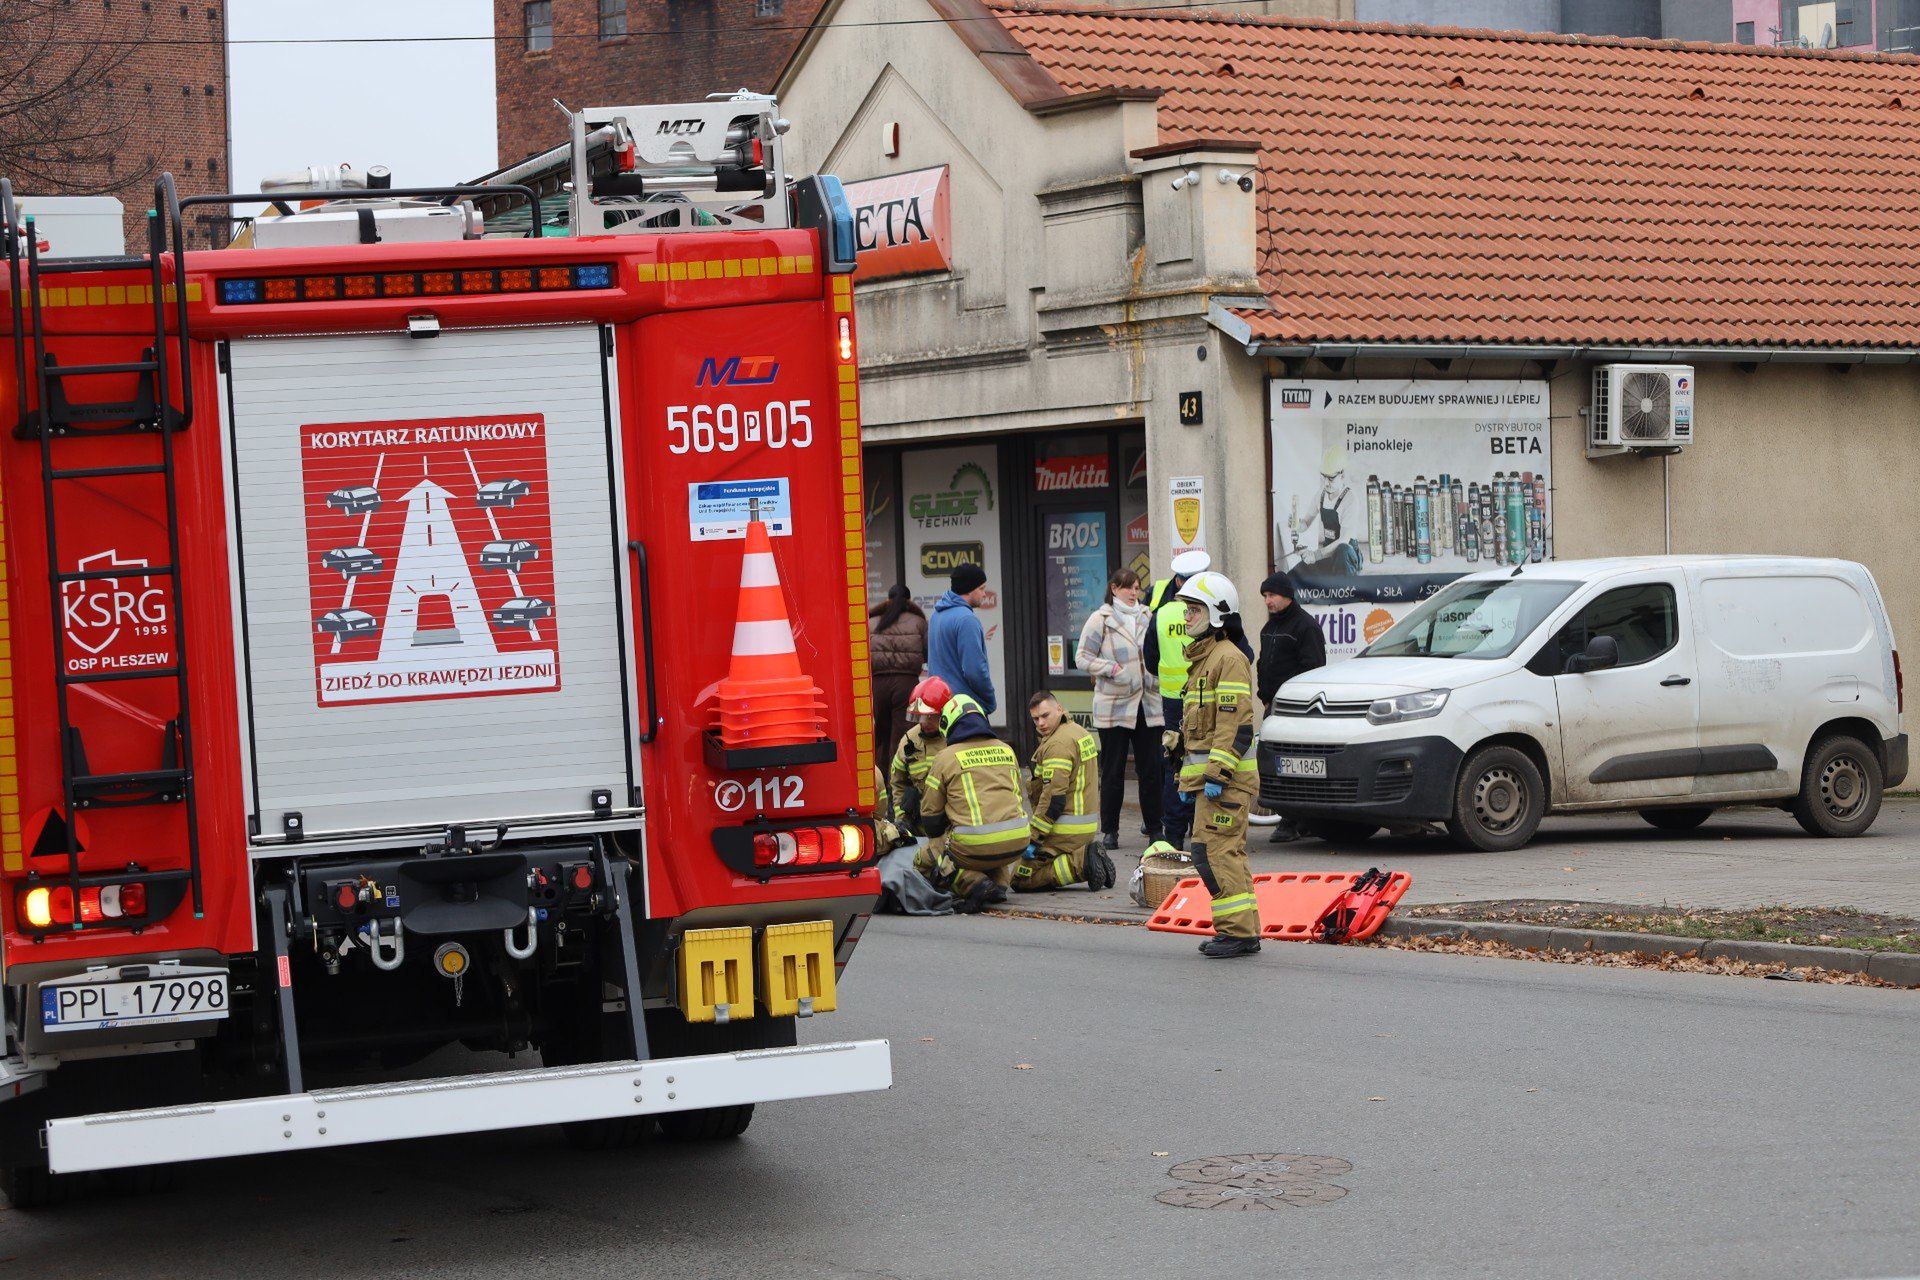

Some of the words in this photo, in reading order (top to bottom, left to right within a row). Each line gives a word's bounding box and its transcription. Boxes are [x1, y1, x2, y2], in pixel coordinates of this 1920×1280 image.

[1283, 389, 1311, 403] TYTAN
[1338, 394, 1376, 405] RAZEM
[1379, 394, 1435, 405] BUDUJEMY
[1438, 394, 1499, 405] SPRAWNIEJ
[1507, 395, 1541, 405] LEPIEJ
[1181, 397, 1197, 417] 43
[1346, 423, 1378, 438] Piany
[1474, 423, 1543, 433] DYSTRYBUTOR
[311, 428, 410, 450] KORYTARZ
[415, 422, 539, 445] RATUNKOWY
[1353, 440, 1413, 454] pianokleje
[1491, 437, 1542, 455] BETA
[917, 516, 972, 529] TECHNIK
[1048, 521, 1100, 550] BROS
[926, 550, 981, 570] COVAL
[1297, 586, 1357, 599] WYDAJNOŚĆ
[1383, 587, 1403, 597] SIŁA
[62, 589, 167, 629] KSRG
[134, 625, 168, 636] 1995
[69, 656, 97, 671] OSP
[102, 652, 169, 669] PLESZEW
[325, 672, 372, 692] ZJEDŹ
[377, 672, 403, 689] DO
[407, 668, 494, 687] KRAWĘDZI
[498, 663, 553, 681] JEZDNI
[1220, 695, 1236, 703] OSP
[965, 748, 1005, 757] OCHOTNICZA
[1281, 757, 1297, 770] PPL
[1299, 757, 1325, 775] 18457
[747, 775, 805, 810] 112
[1215, 815, 1231, 825] OSP
[60, 988, 118, 1021] PPL
[132, 979, 225, 1015] 17998
[44, 1010, 57, 1021] PL
